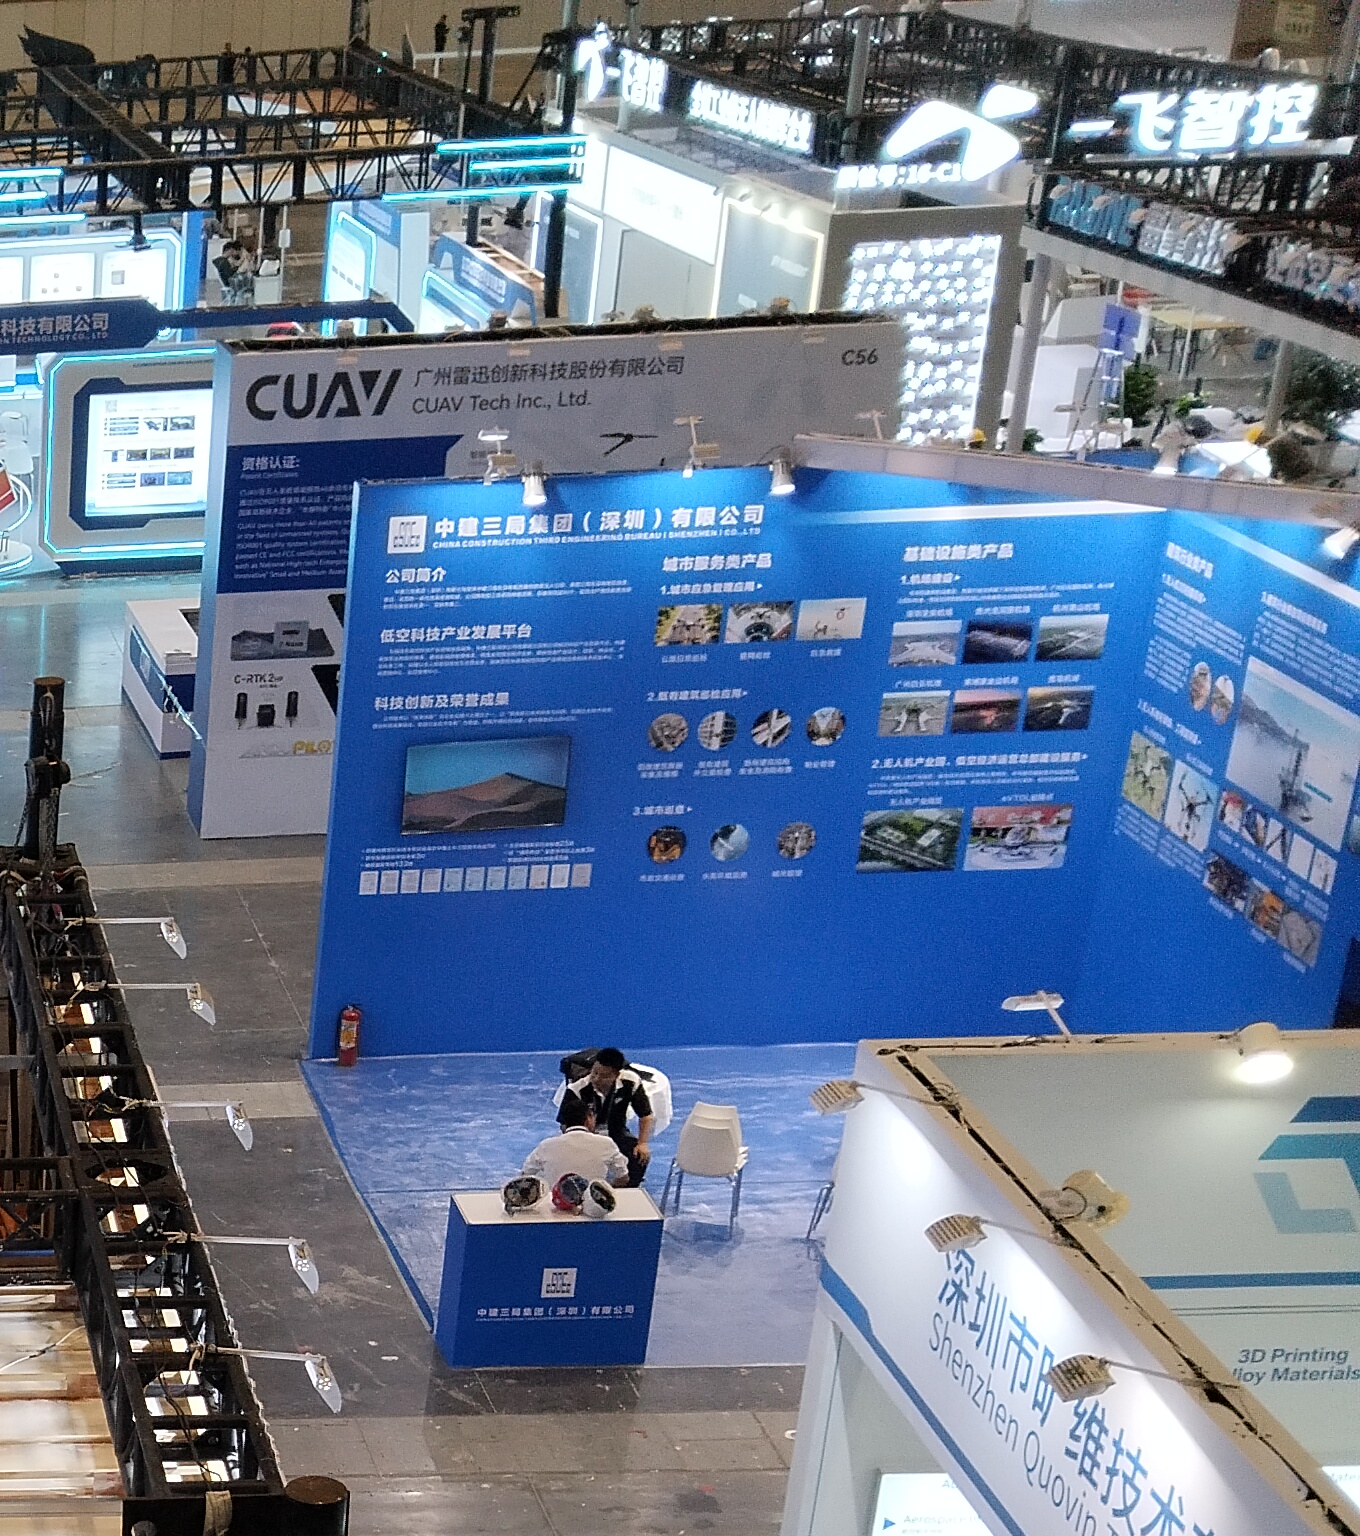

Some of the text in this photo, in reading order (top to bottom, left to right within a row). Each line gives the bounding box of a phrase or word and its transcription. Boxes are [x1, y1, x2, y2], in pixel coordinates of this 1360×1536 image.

[1067, 82, 1321, 150] 一飞智控
[841, 347, 878, 367] C56
[413, 355, 685, 389] 广州雷迅创新科技股份有限公司
[246, 368, 402, 422] CUAV
[412, 394, 465, 414] CUAV
[469, 393, 511, 412] Tech
[557, 388, 591, 408] Ltd.
[385, 566, 447, 584] 公司简介
[380, 624, 532, 644] 低空科技产业发展平台
[374, 692, 510, 711] 科技创新及荣誉成果
[1237, 1347, 1350, 1365] 3D Printing
[929, 1311, 1020, 1453] Shenzhen
[1270, 1364, 1360, 1382] Materials
